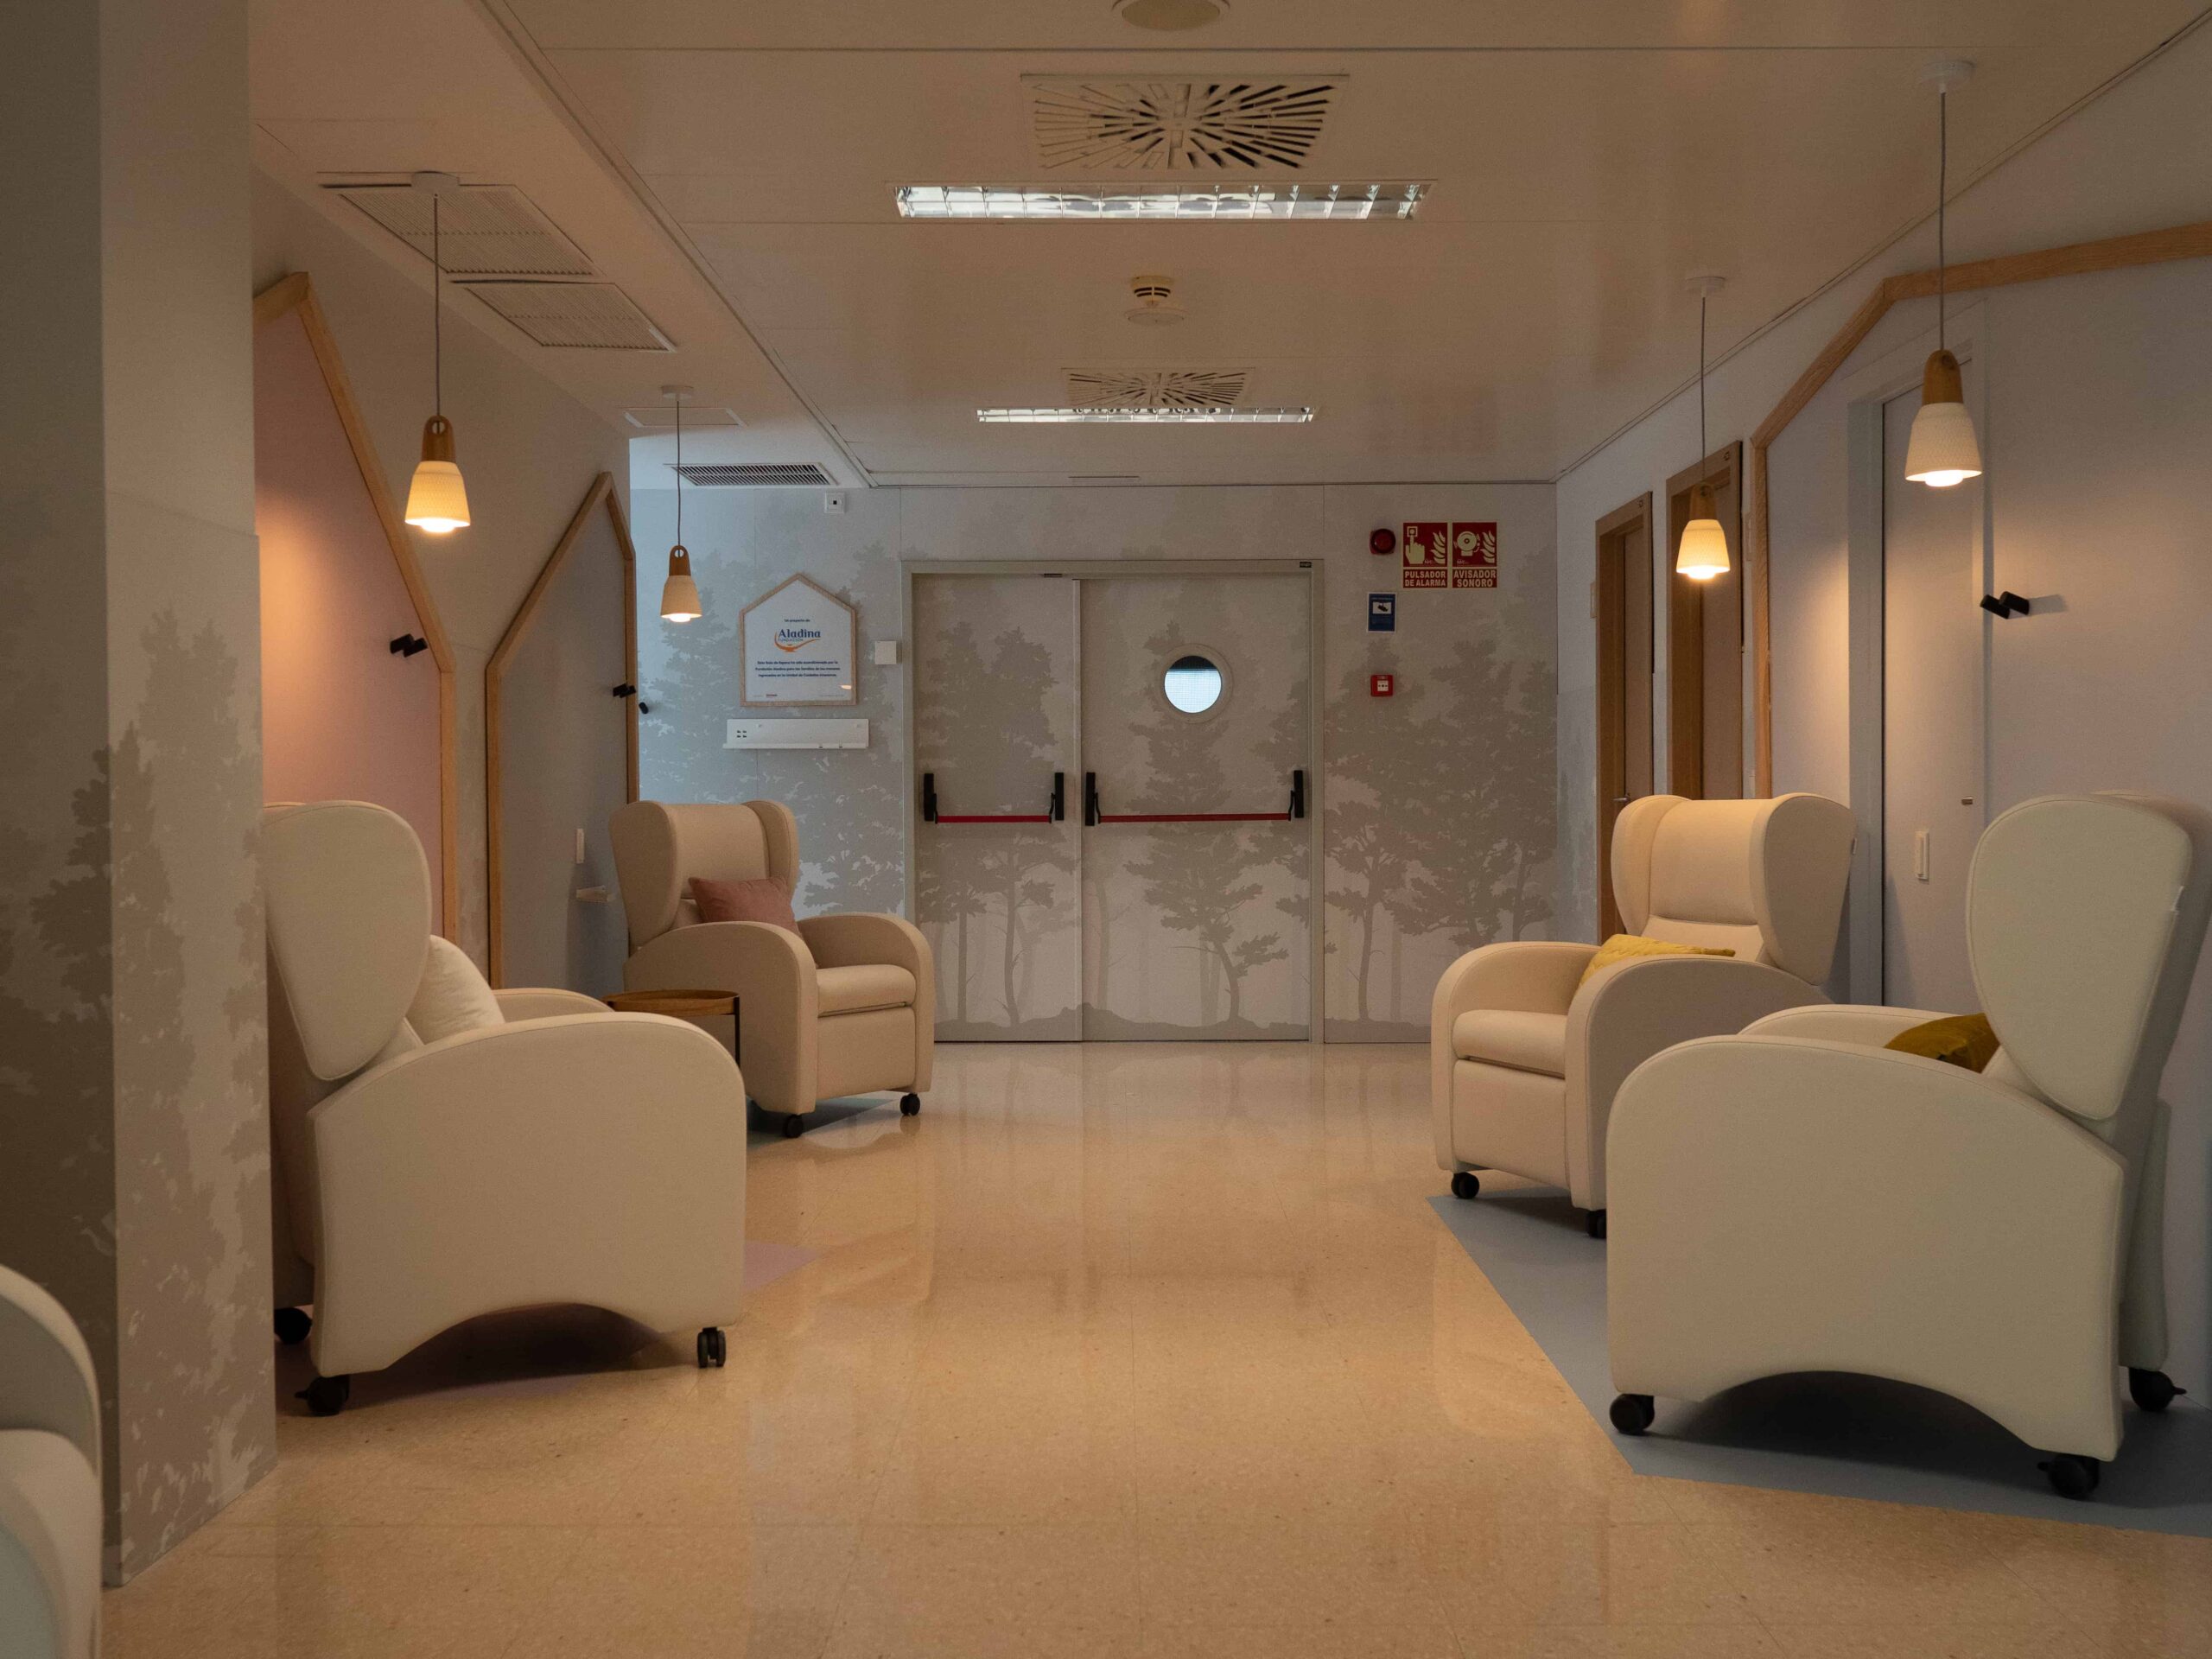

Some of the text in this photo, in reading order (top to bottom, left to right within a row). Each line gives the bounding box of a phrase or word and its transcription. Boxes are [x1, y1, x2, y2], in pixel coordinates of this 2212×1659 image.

[1404, 570, 1446, 579] PULSADOR
[1453, 569, 1497, 579] AVISADOR
[1457, 578, 1493, 588] SONORO
[779, 628, 821, 638] Aladina
